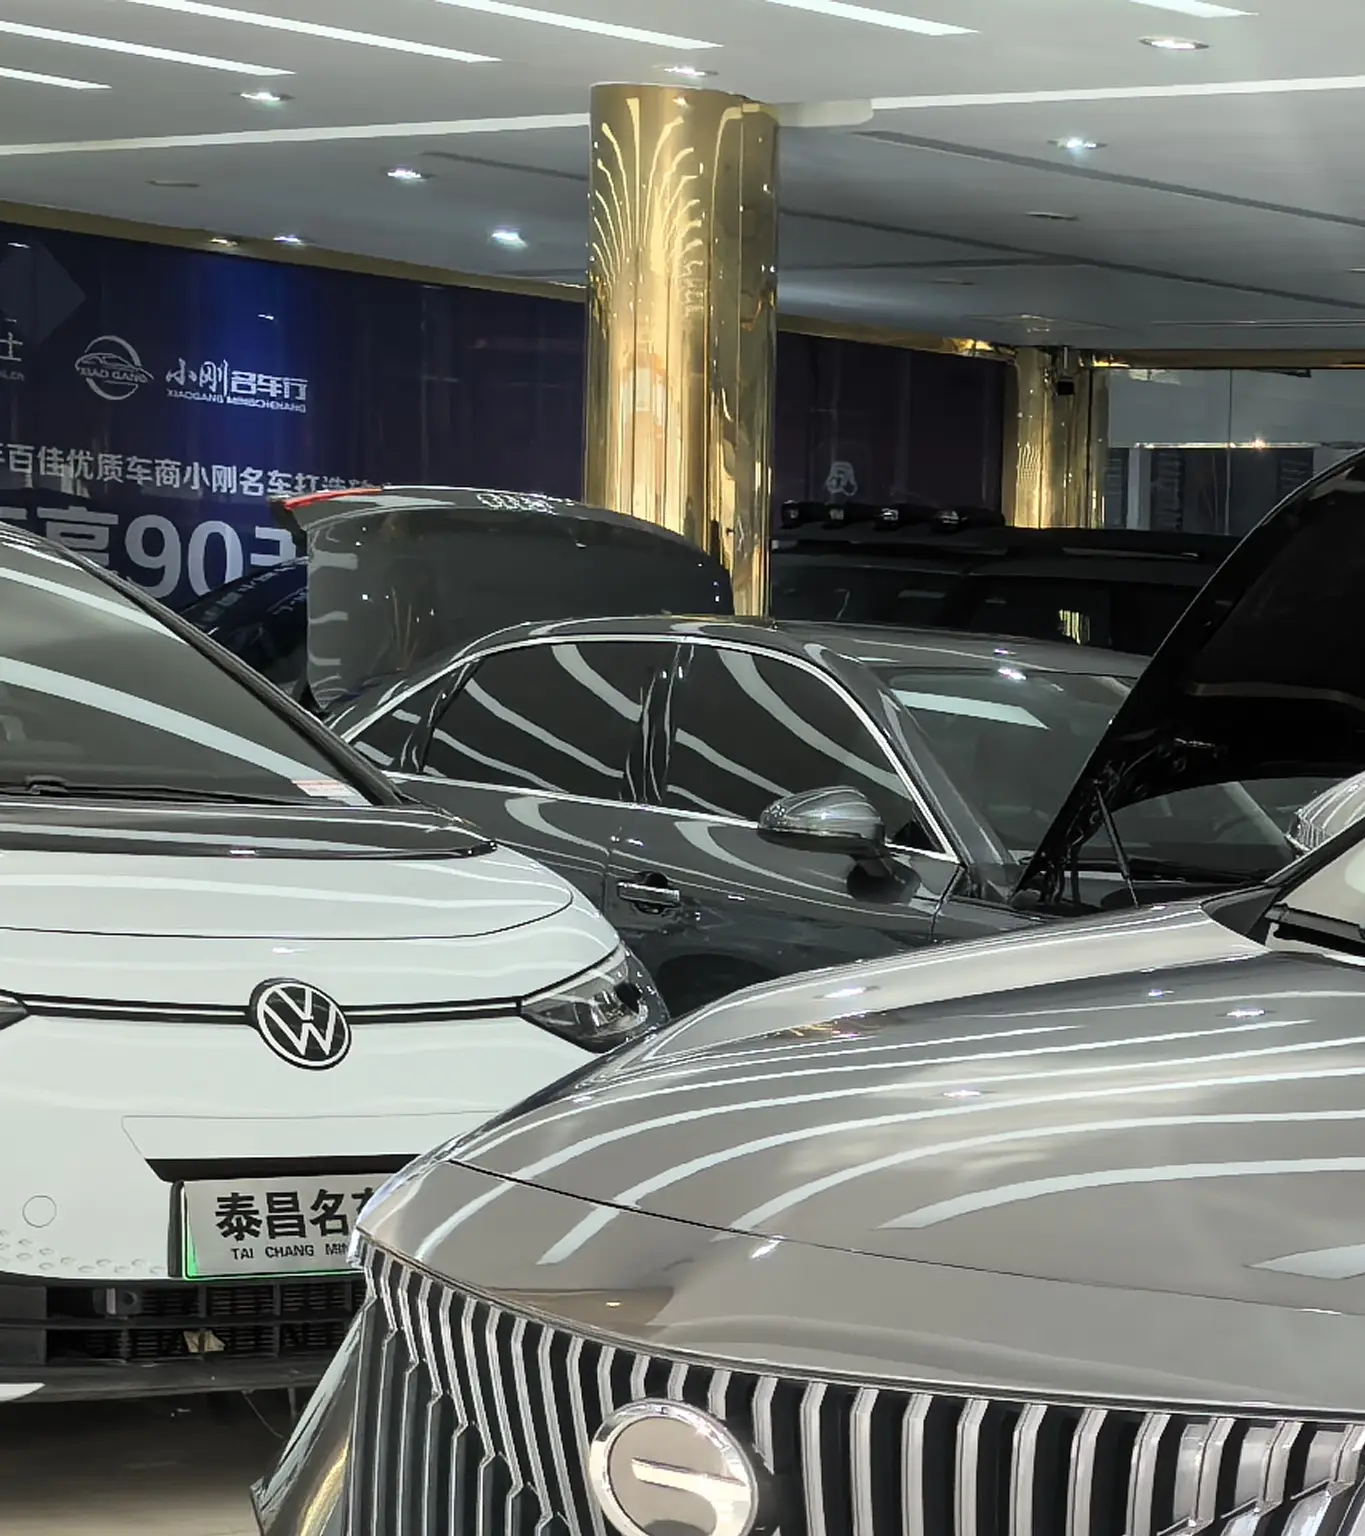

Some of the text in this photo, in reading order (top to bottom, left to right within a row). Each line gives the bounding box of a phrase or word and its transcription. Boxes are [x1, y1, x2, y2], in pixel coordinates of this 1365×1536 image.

[165, 357, 308, 400] 小刚名车行
[231, 1247, 254, 1260] TAI
[265, 1244, 315, 1259] CHANG
